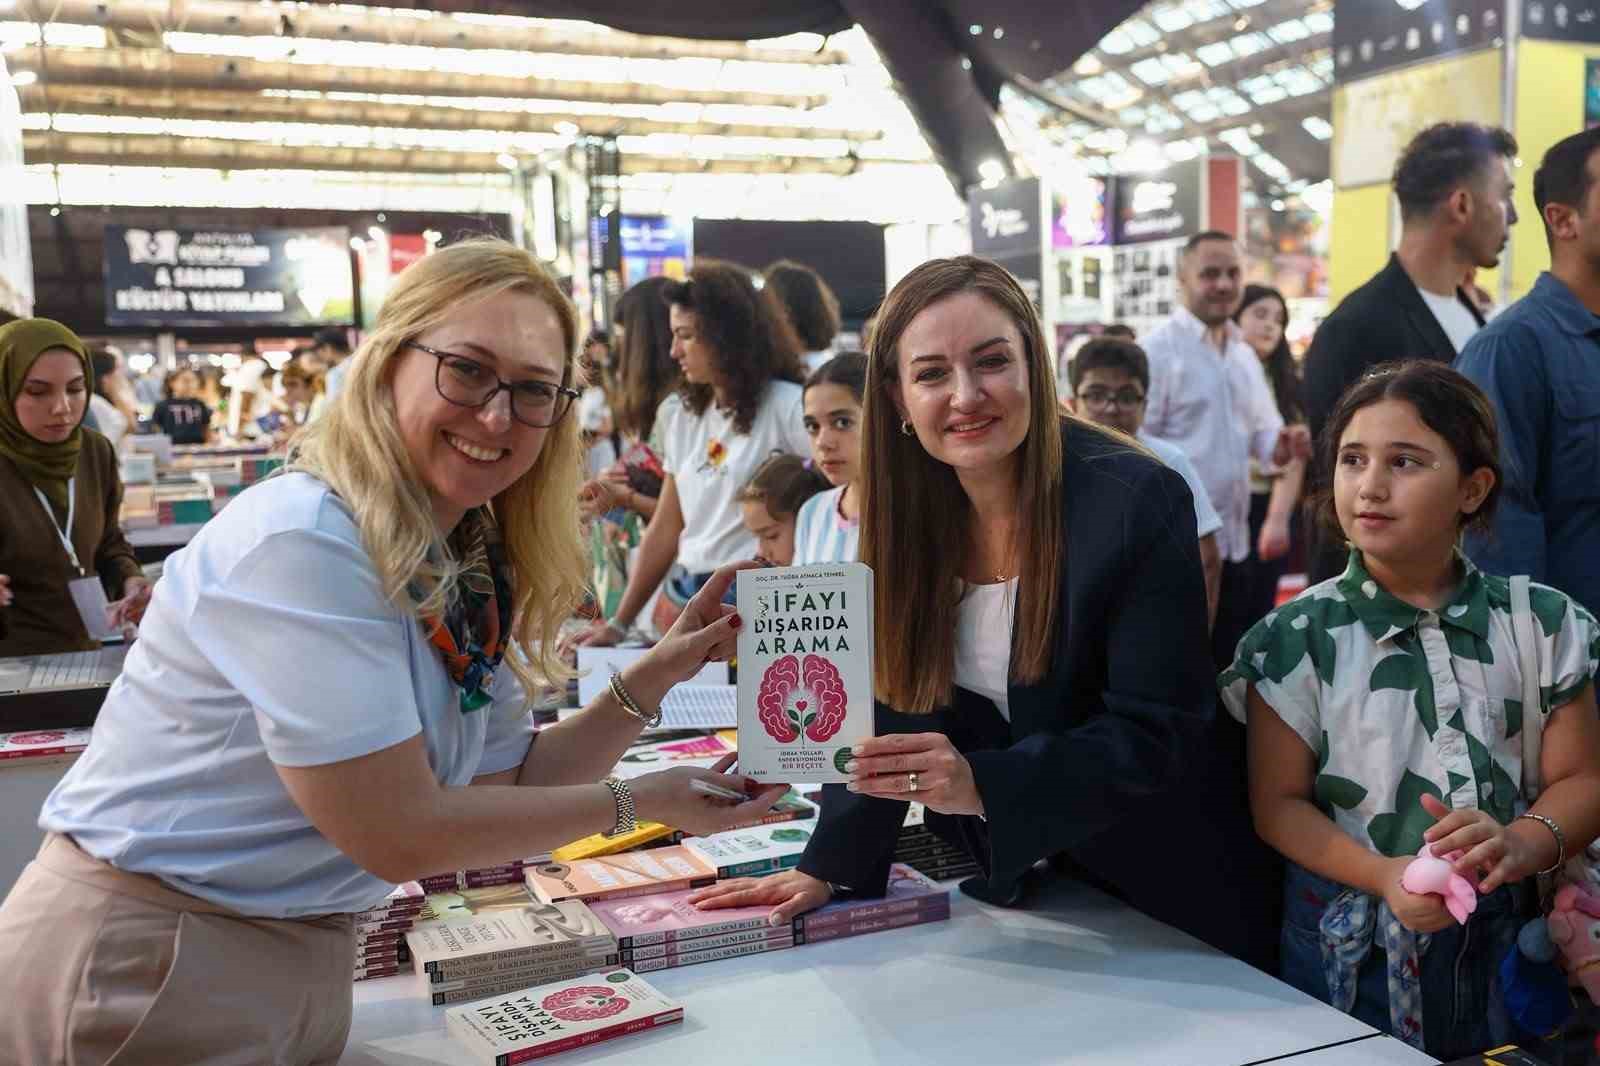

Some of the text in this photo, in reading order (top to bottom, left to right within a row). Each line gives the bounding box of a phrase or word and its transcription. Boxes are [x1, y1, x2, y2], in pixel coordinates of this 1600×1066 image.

[754, 615, 850, 636] DIŞARIDA
[755, 635, 850, 655] ARAMA
[477, 1006, 527, 1042] ŞİFAYI
[499, 1001, 546, 1037] DIŞARIDA
[517, 996, 563, 1030] ARAMA
